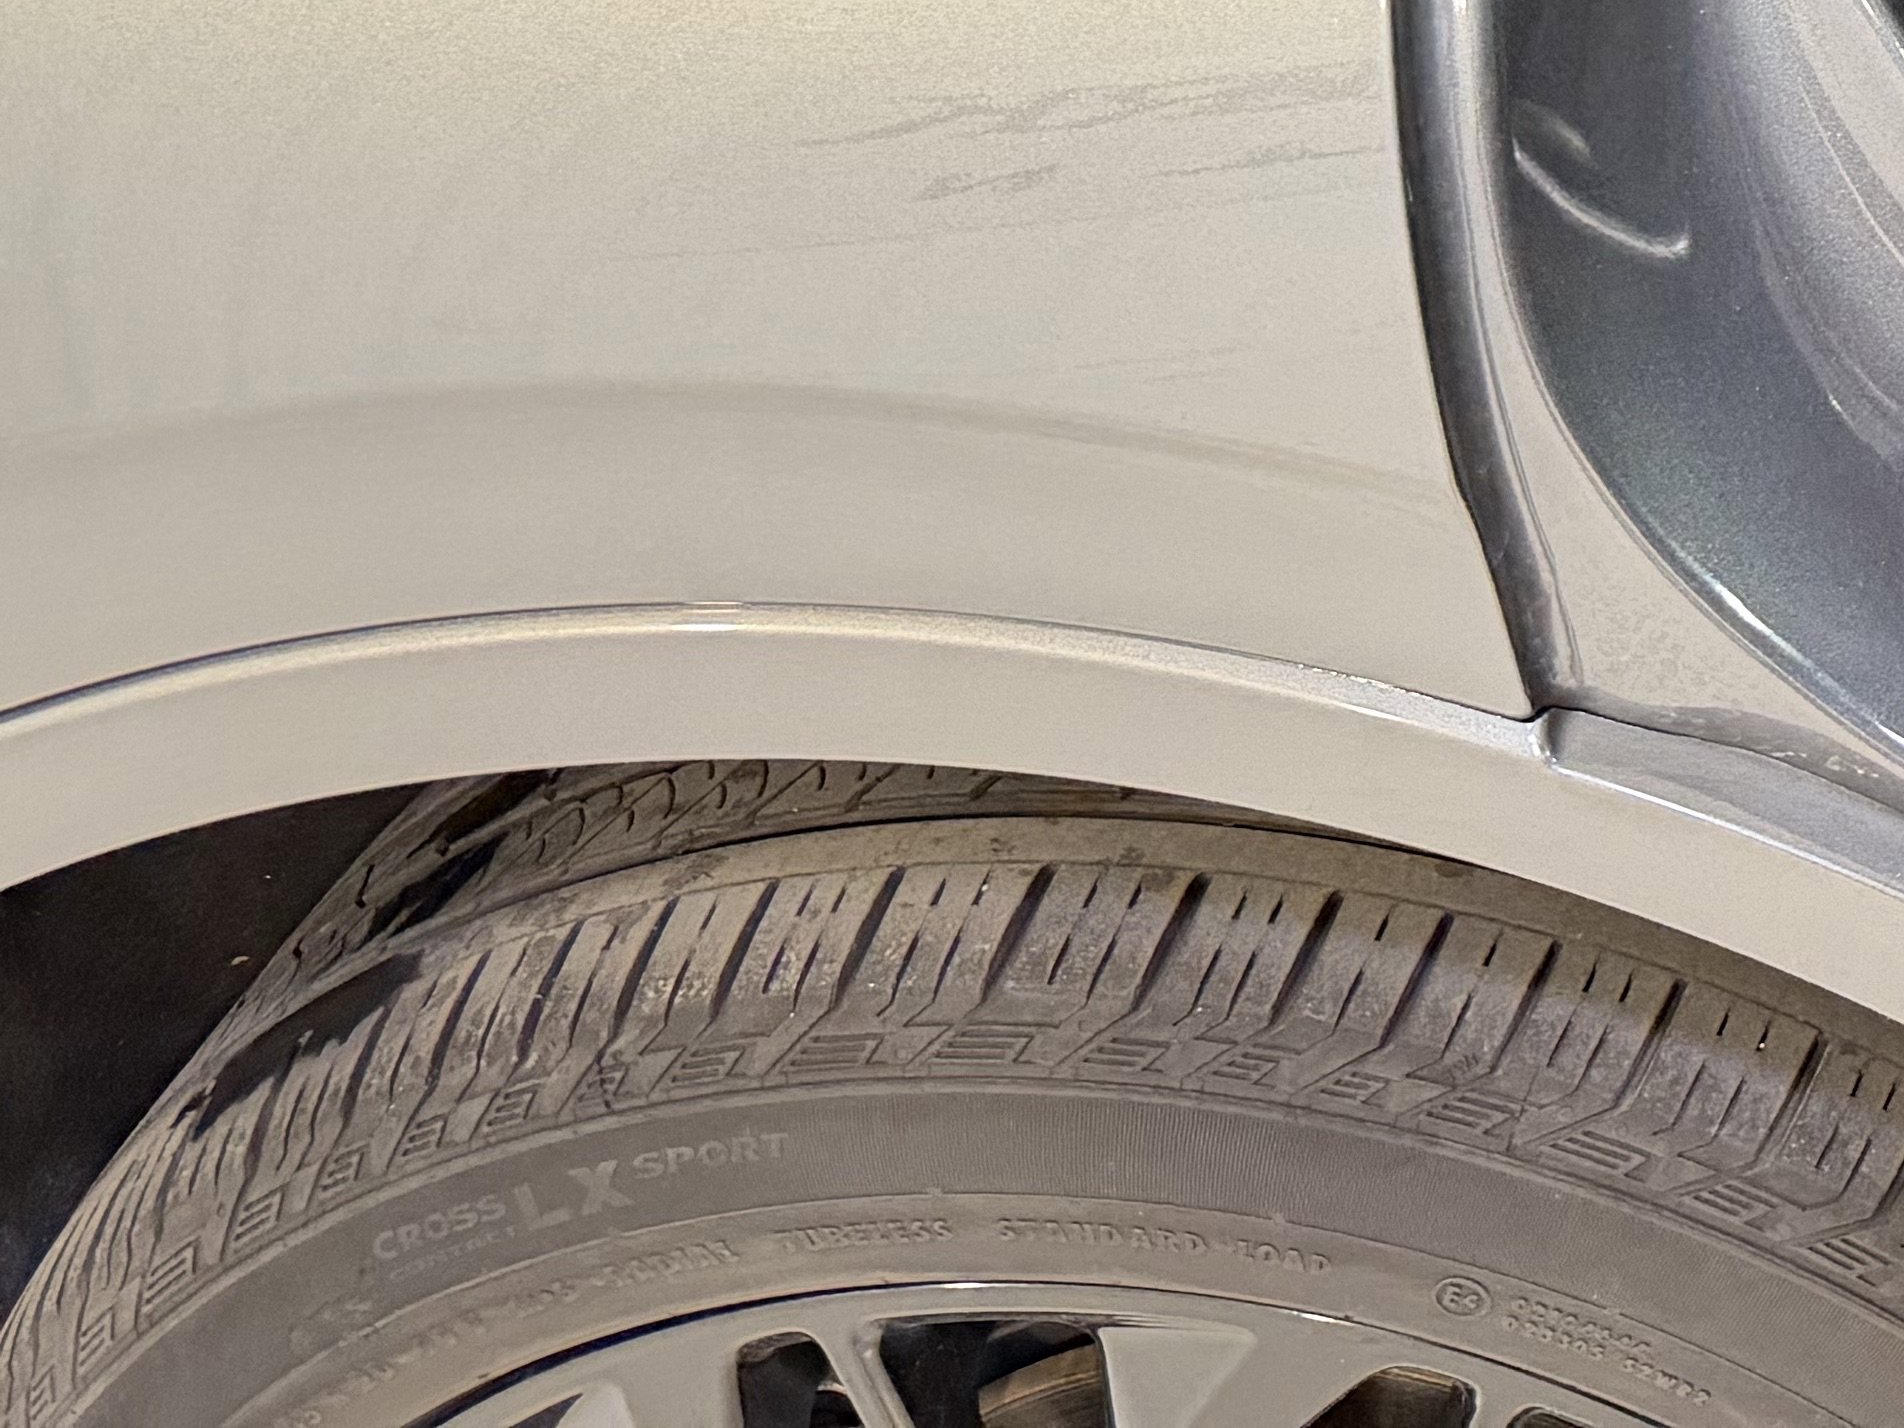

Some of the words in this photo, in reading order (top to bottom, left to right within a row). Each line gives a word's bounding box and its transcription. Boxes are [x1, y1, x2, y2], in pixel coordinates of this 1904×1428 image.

[372, 1193, 507, 1260] CROSS
[513, 1159, 634, 1231] LX
[632, 1131, 788, 1180] SPORT
[773, 1218, 953, 1254] TUBELESS
[998, 1217, 1207, 1255] STANDARD
[1234, 1237, 1333, 1275] LOAD
